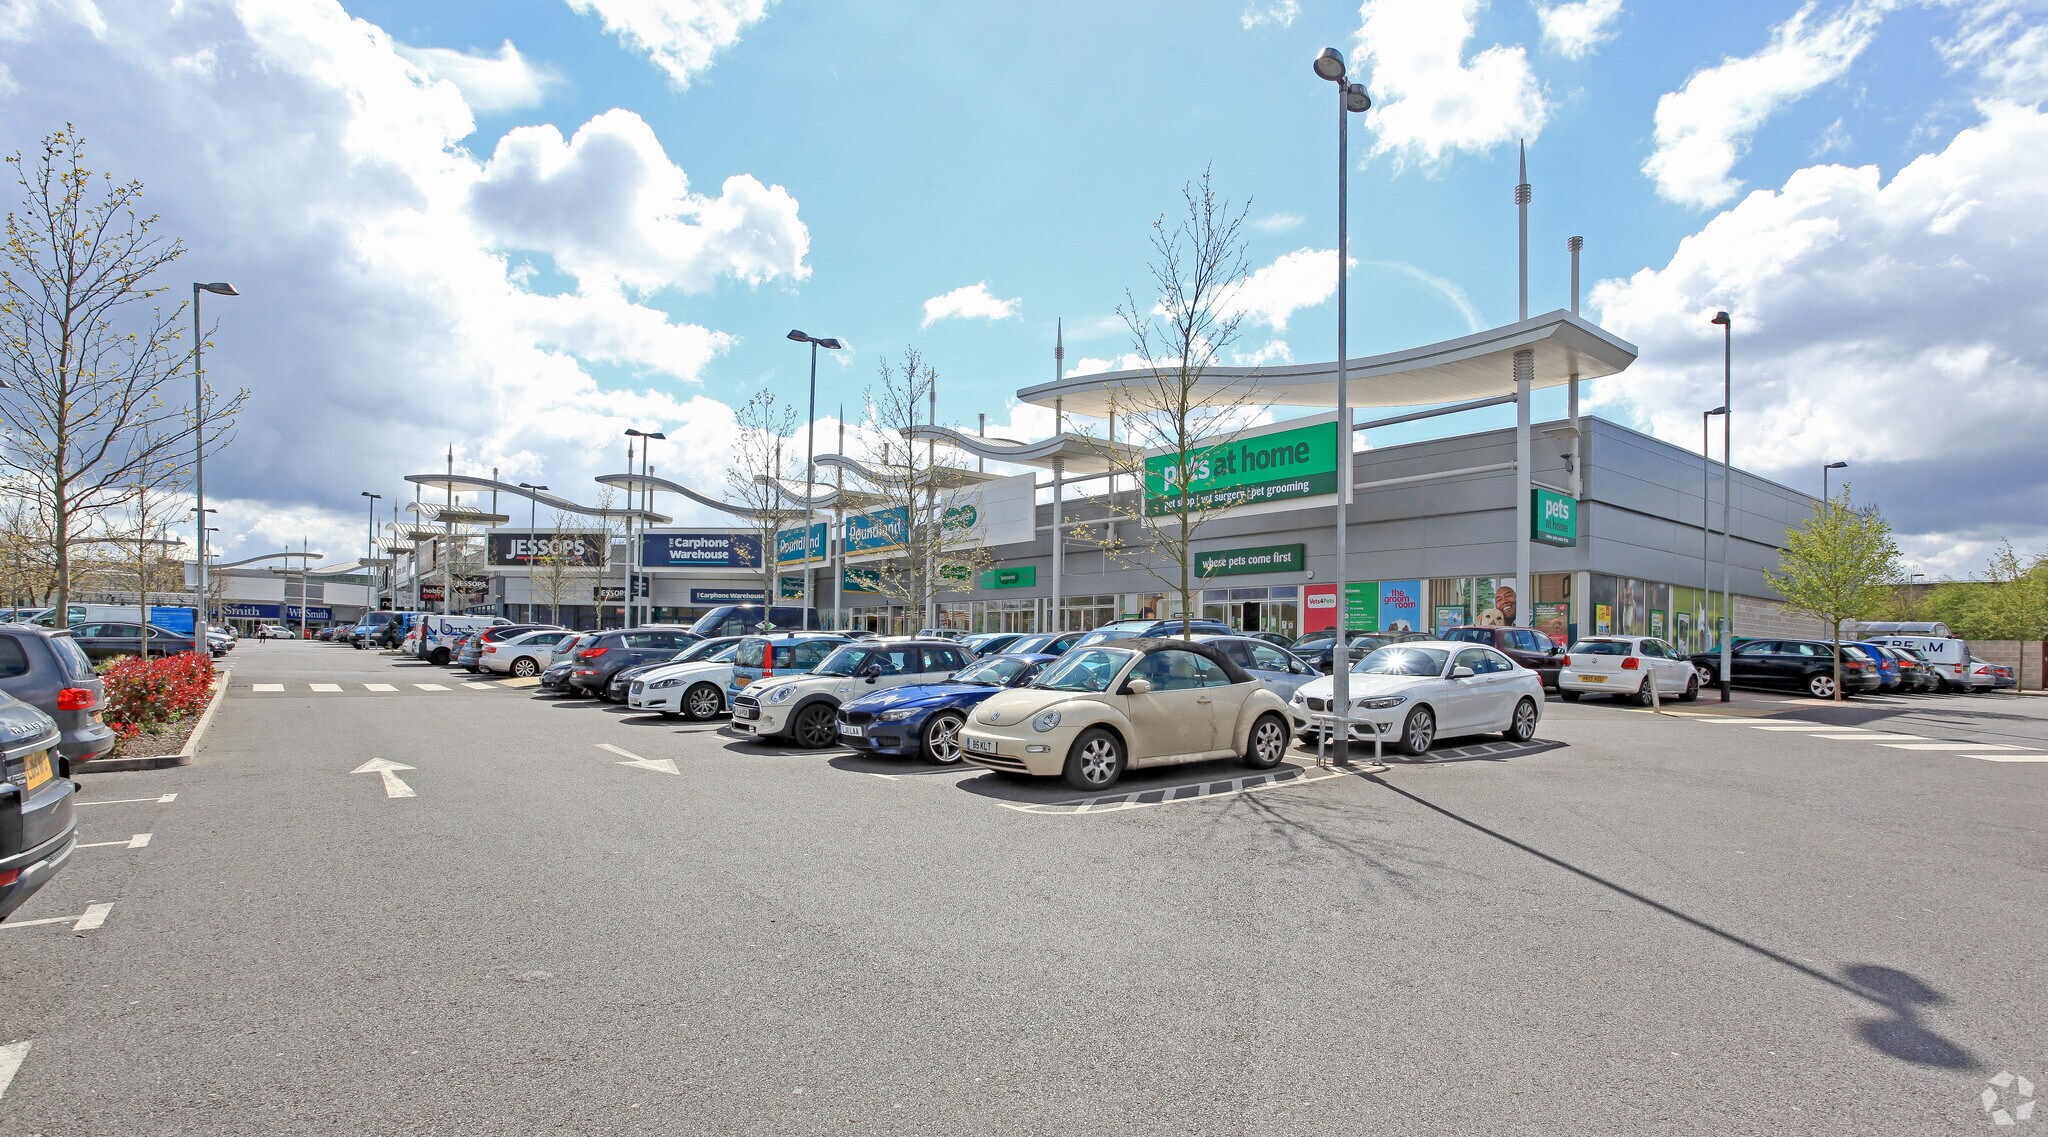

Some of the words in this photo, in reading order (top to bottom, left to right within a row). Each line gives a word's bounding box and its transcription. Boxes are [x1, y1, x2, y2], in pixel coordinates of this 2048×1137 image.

[1213, 452, 1236, 477] at
[1241, 441, 1310, 472] home
[1177, 494, 1194, 508] sop
[1214, 489, 1245, 503] surgery
[1251, 486, 1264, 499] pet
[1266, 480, 1310, 497] grooming
[1545, 499, 1569, 520] pets
[1545, 518, 1552, 530] at
[1552, 517, 1569, 533] home
[506, 539, 585, 560] JESSOPS
[675, 537, 729, 550] Carphone
[779, 532, 820, 553] Poundlnd
[669, 550, 729, 559] Warehouse
[1202, 556, 1227, 569] where
[1228, 555, 1246, 569] pets
[1247, 554, 1271, 565] come
[1273, 552, 1292, 563] first
[700, 592, 729, 601] Carphone
[730, 592, 766, 600] Warehouse
[1384, 596, 1410, 605] groom
[1391, 588, 1405, 597] the
[1394, 601, 1416, 609] room
